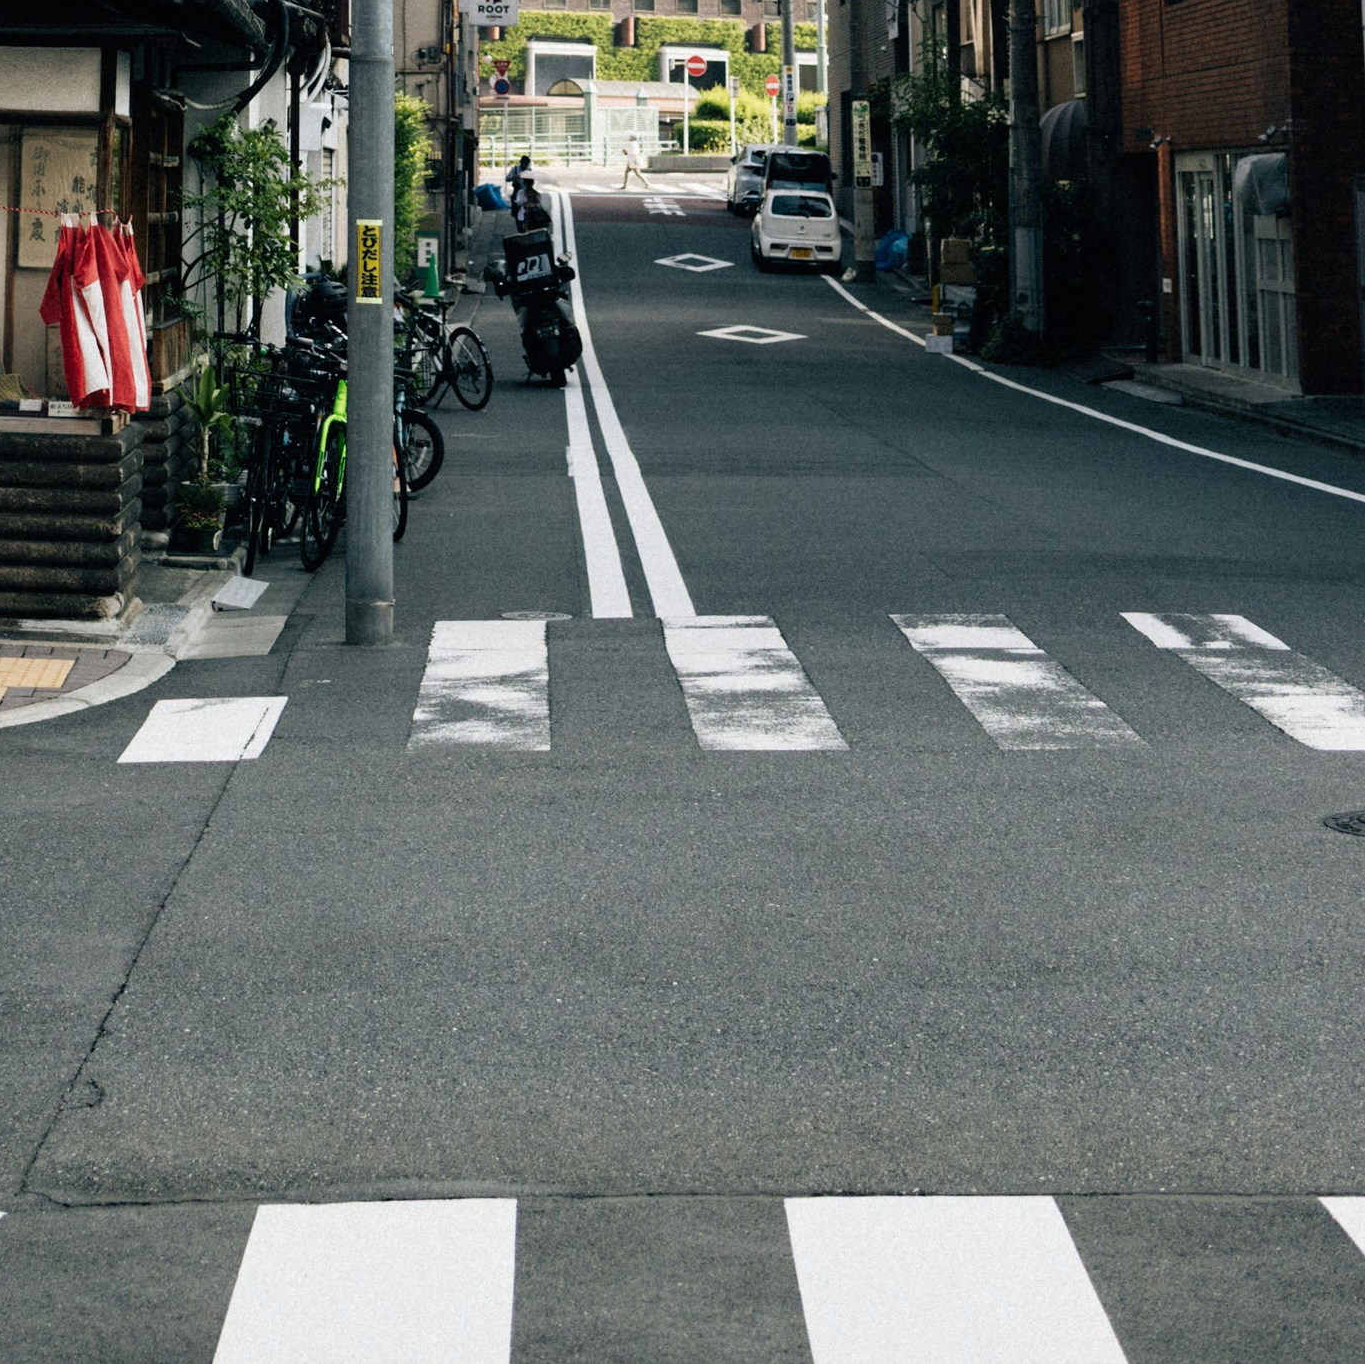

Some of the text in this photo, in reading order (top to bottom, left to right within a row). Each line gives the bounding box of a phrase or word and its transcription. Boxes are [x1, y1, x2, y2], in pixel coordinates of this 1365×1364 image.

[477, 5, 510, 14] ROOT
[361, 225, 378, 298] とびだし注意
